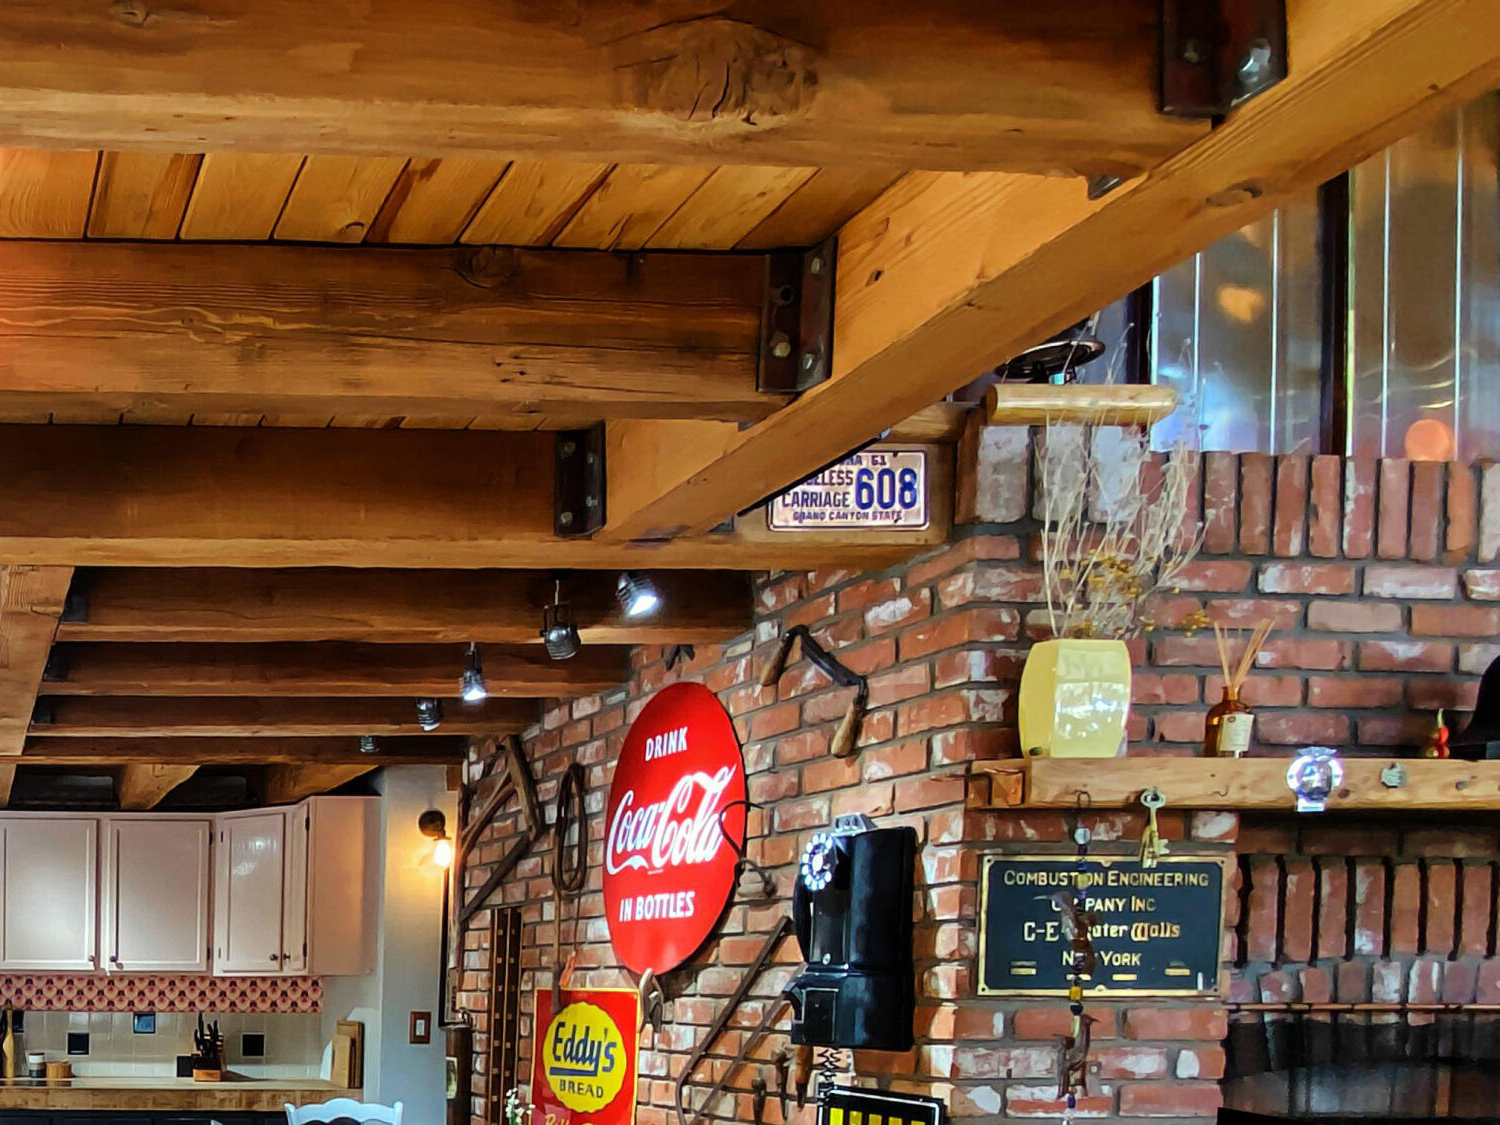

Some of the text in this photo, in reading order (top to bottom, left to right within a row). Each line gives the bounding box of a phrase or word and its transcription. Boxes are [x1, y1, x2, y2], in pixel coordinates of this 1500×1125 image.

[781, 491, 850, 508] CARRIAGE
[855, 468, 918, 510] 608
[793, 510, 903, 521] GRAND CANYON STATE
[645, 727, 688, 762] DRINK
[606, 763, 737, 875] Coca-Cola
[1004, 870, 1209, 887] COMBUSTON ENGINEERING
[619, 891, 695, 922] IN BOTTLES
[1100, 950, 1142, 967] YORK
[552, 1021, 617, 1075] Eddy's
[559, 1079, 604, 1099] BREAD
